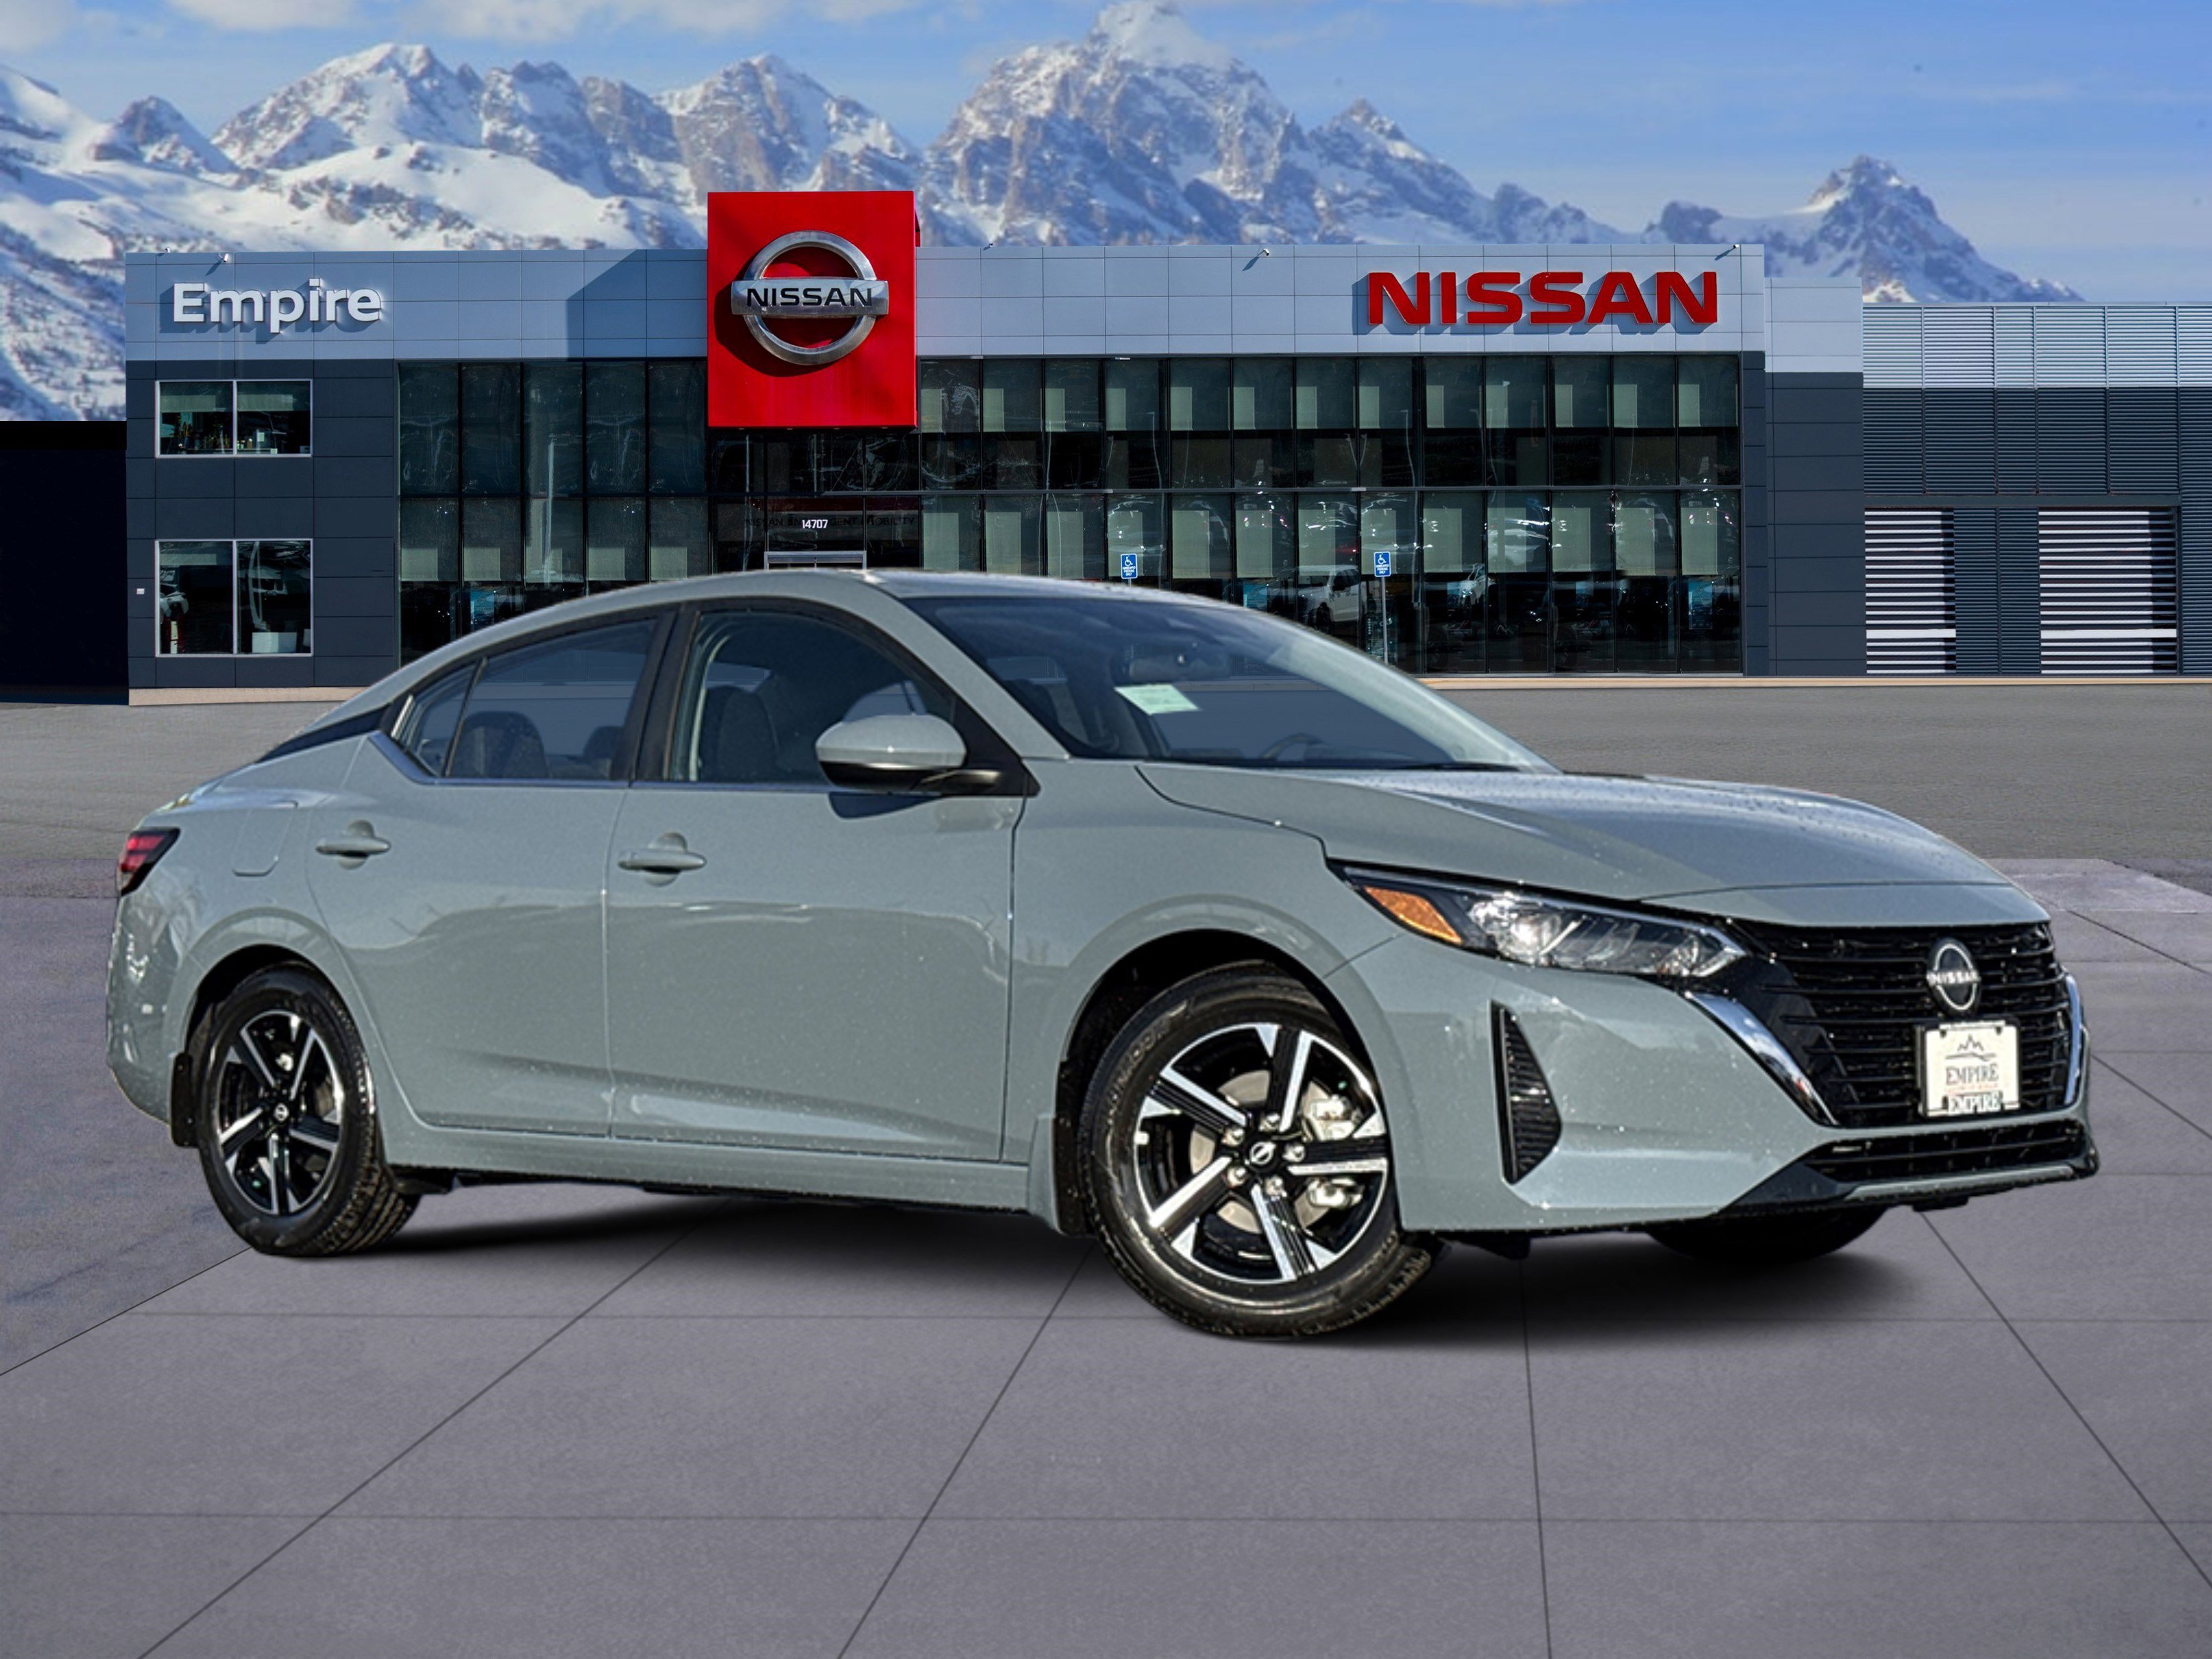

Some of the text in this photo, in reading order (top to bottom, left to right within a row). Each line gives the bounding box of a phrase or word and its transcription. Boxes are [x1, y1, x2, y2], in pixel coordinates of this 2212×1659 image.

[173, 277, 381, 333] Empire
[745, 288, 872, 307] NISSAN
[1368, 271, 1717, 324] NISSAN
[802, 519, 828, 529] 14707
[1945, 1063, 2000, 1085] EMPIRE
